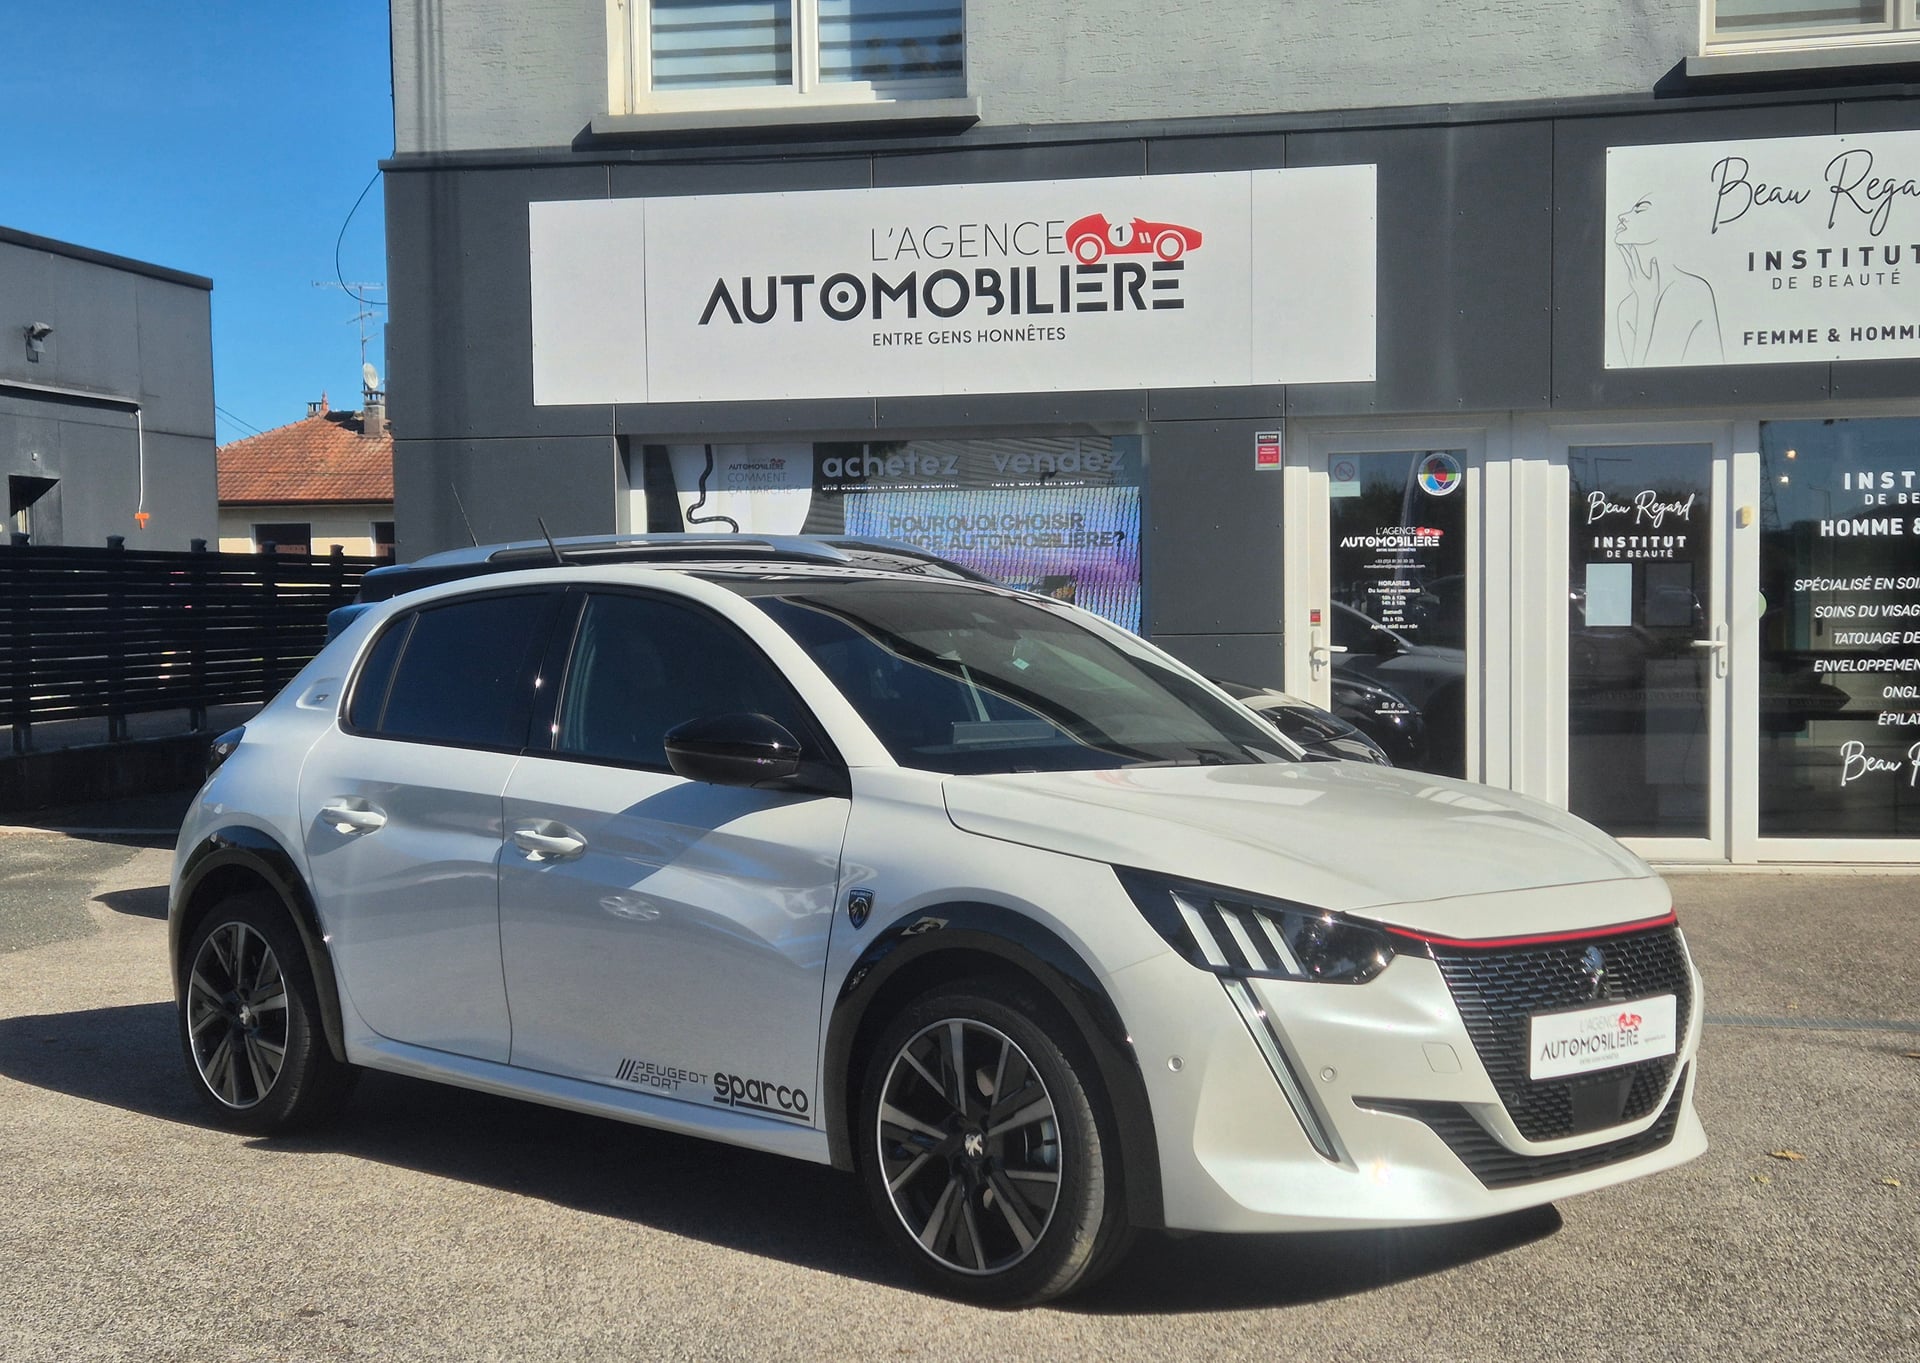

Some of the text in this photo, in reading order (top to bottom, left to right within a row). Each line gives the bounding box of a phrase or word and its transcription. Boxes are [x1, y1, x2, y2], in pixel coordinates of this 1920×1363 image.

[1710, 156, 1811, 234] Beau
[872, 220, 1066, 261] L'AGENCE
[1772, 269, 1901, 290] DE BEAUTÉ
[873, 324, 1067, 347] ENTRE GENS HONNÊTES
[1743, 325, 1920, 346] FEMME & HOMM
[822, 440, 1126, 478] achetez vendez
[1586, 490, 1696, 528] Beau Regard
[1864, 493, 1887, 505] DE
[889, 512, 1085, 533] POURQUOI CHOISIR
[1375, 526, 1417, 536] L'AGENCE
[1820, 518, 1904, 537] HOMME
[1594, 535, 1688, 549] INSTITUT
[1606, 550, 1621, 559] DE
[1793, 575, 1920, 592] SPÉCIALISÉ EN SOI
[1814, 606, 1856, 618] SOINS
[1858, 605, 1879, 618] DU
[1834, 632, 1902, 645] TATOUAGE
[1882, 686, 1920, 698] ONGL
[1840, 740, 1902, 787] Beau
[630, 1071, 682, 1092] SPORT
[635, 1060, 709, 1085] PEUGEOT
[713, 1071, 810, 1113] sparco
